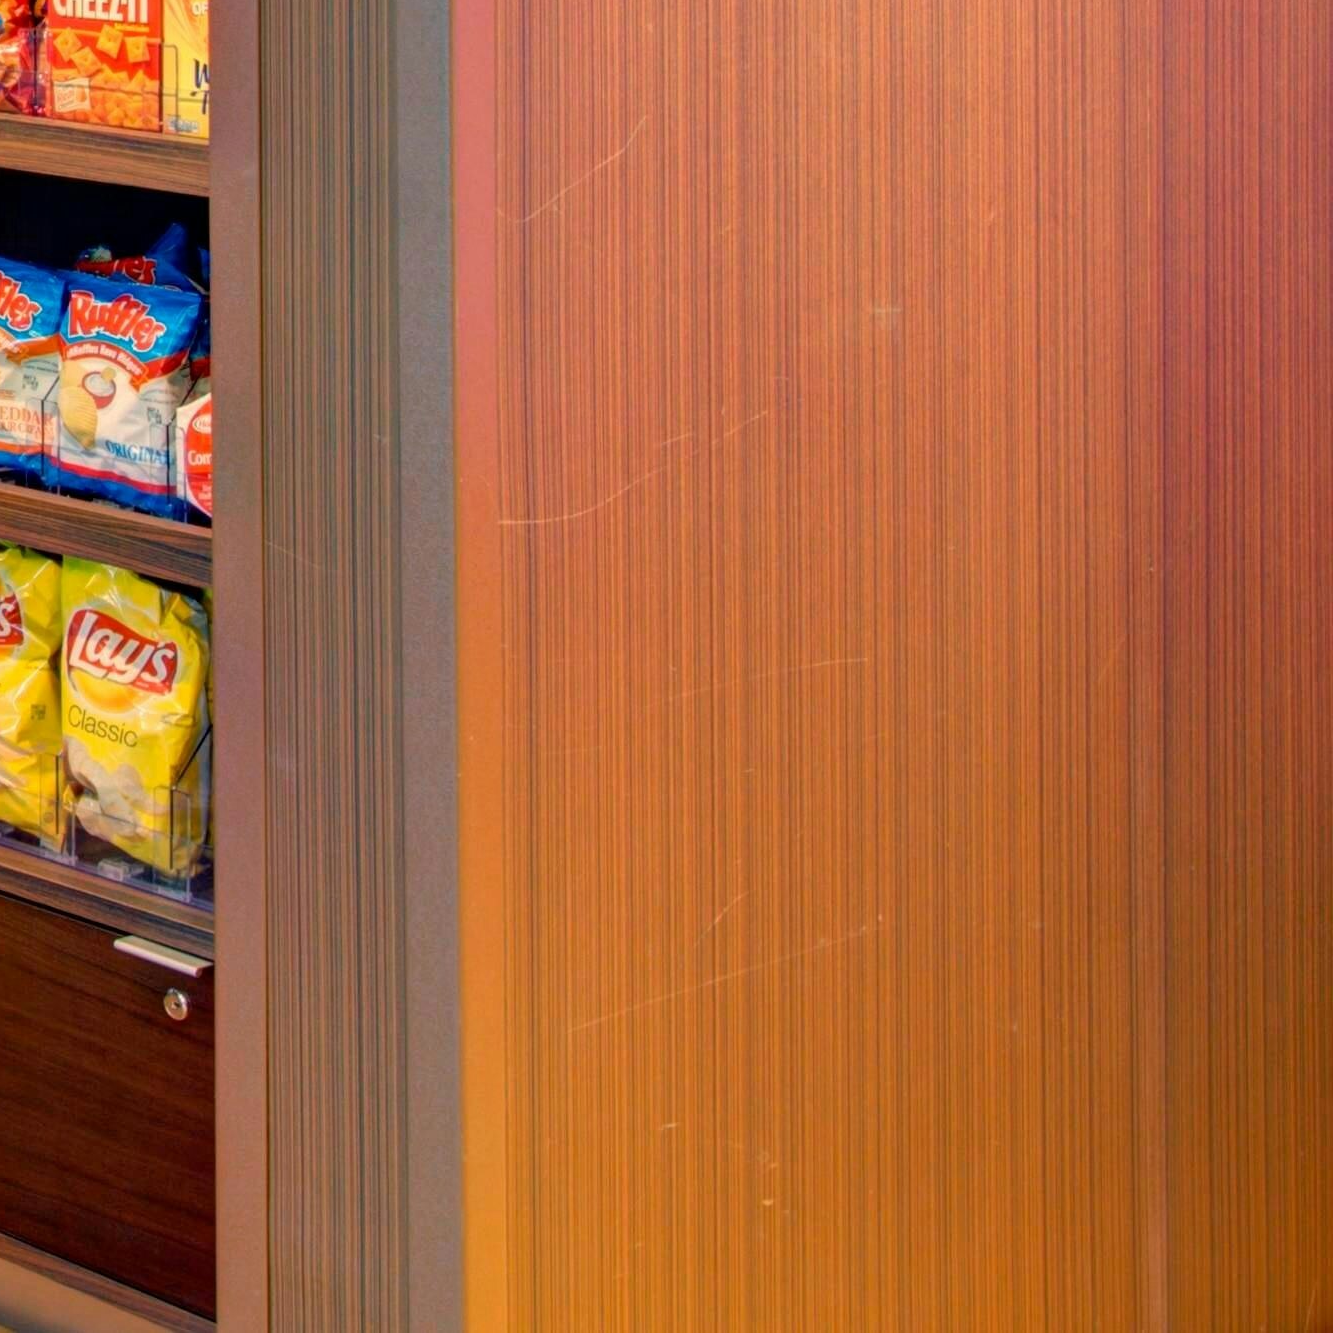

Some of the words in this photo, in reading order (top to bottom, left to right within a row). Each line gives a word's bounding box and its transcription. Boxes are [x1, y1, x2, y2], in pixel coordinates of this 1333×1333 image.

[69, 290, 167, 352] Ruffles
[69, 612, 175, 685] Lay's
[68, 704, 138, 748] Classic
